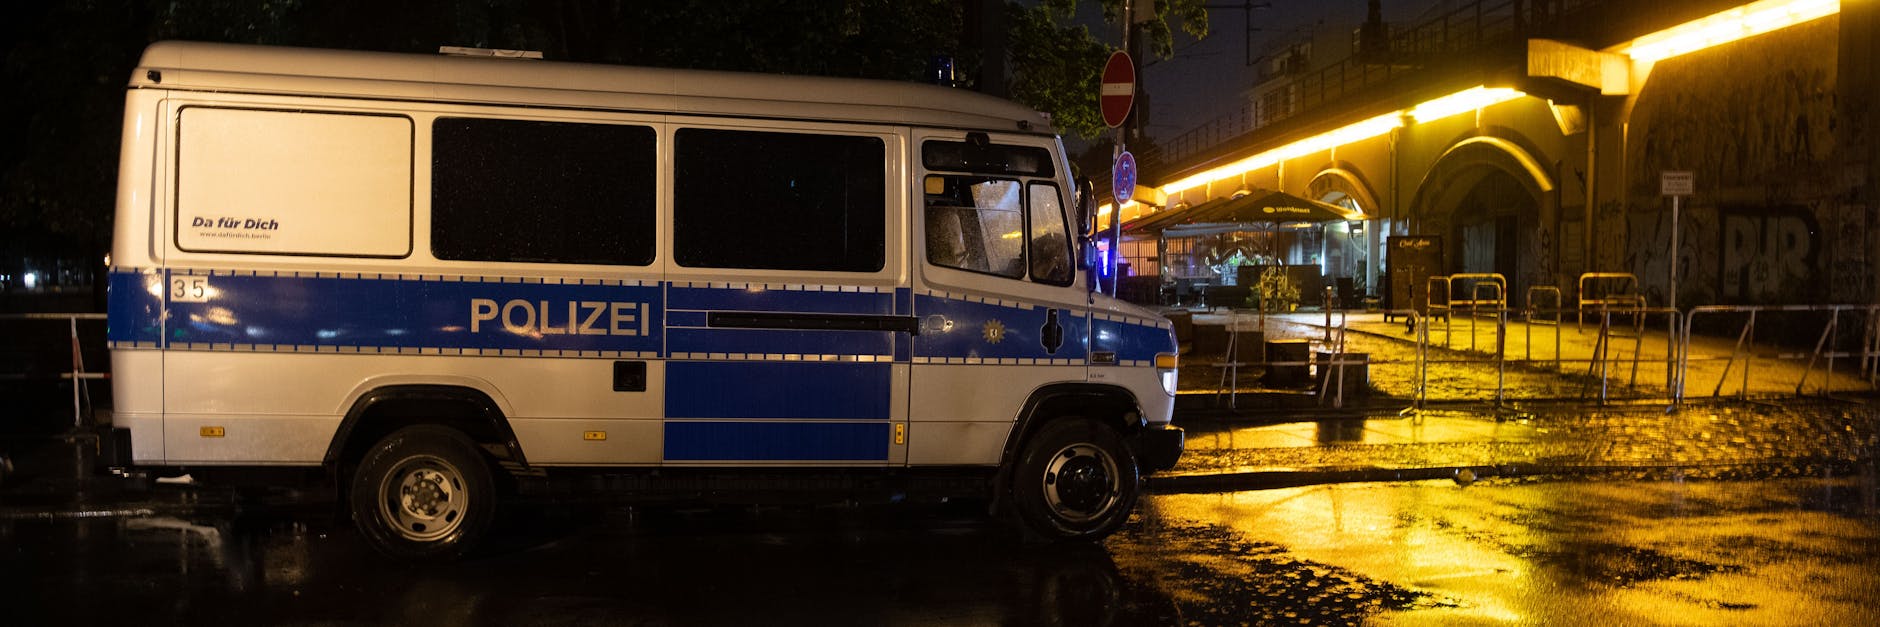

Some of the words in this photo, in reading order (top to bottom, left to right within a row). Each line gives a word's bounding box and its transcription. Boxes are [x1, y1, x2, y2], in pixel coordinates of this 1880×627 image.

[192, 216, 214, 228] Da
[217, 216, 241, 229] für
[244, 218, 279, 230] Dich
[470, 298, 650, 337] POLIZEI
